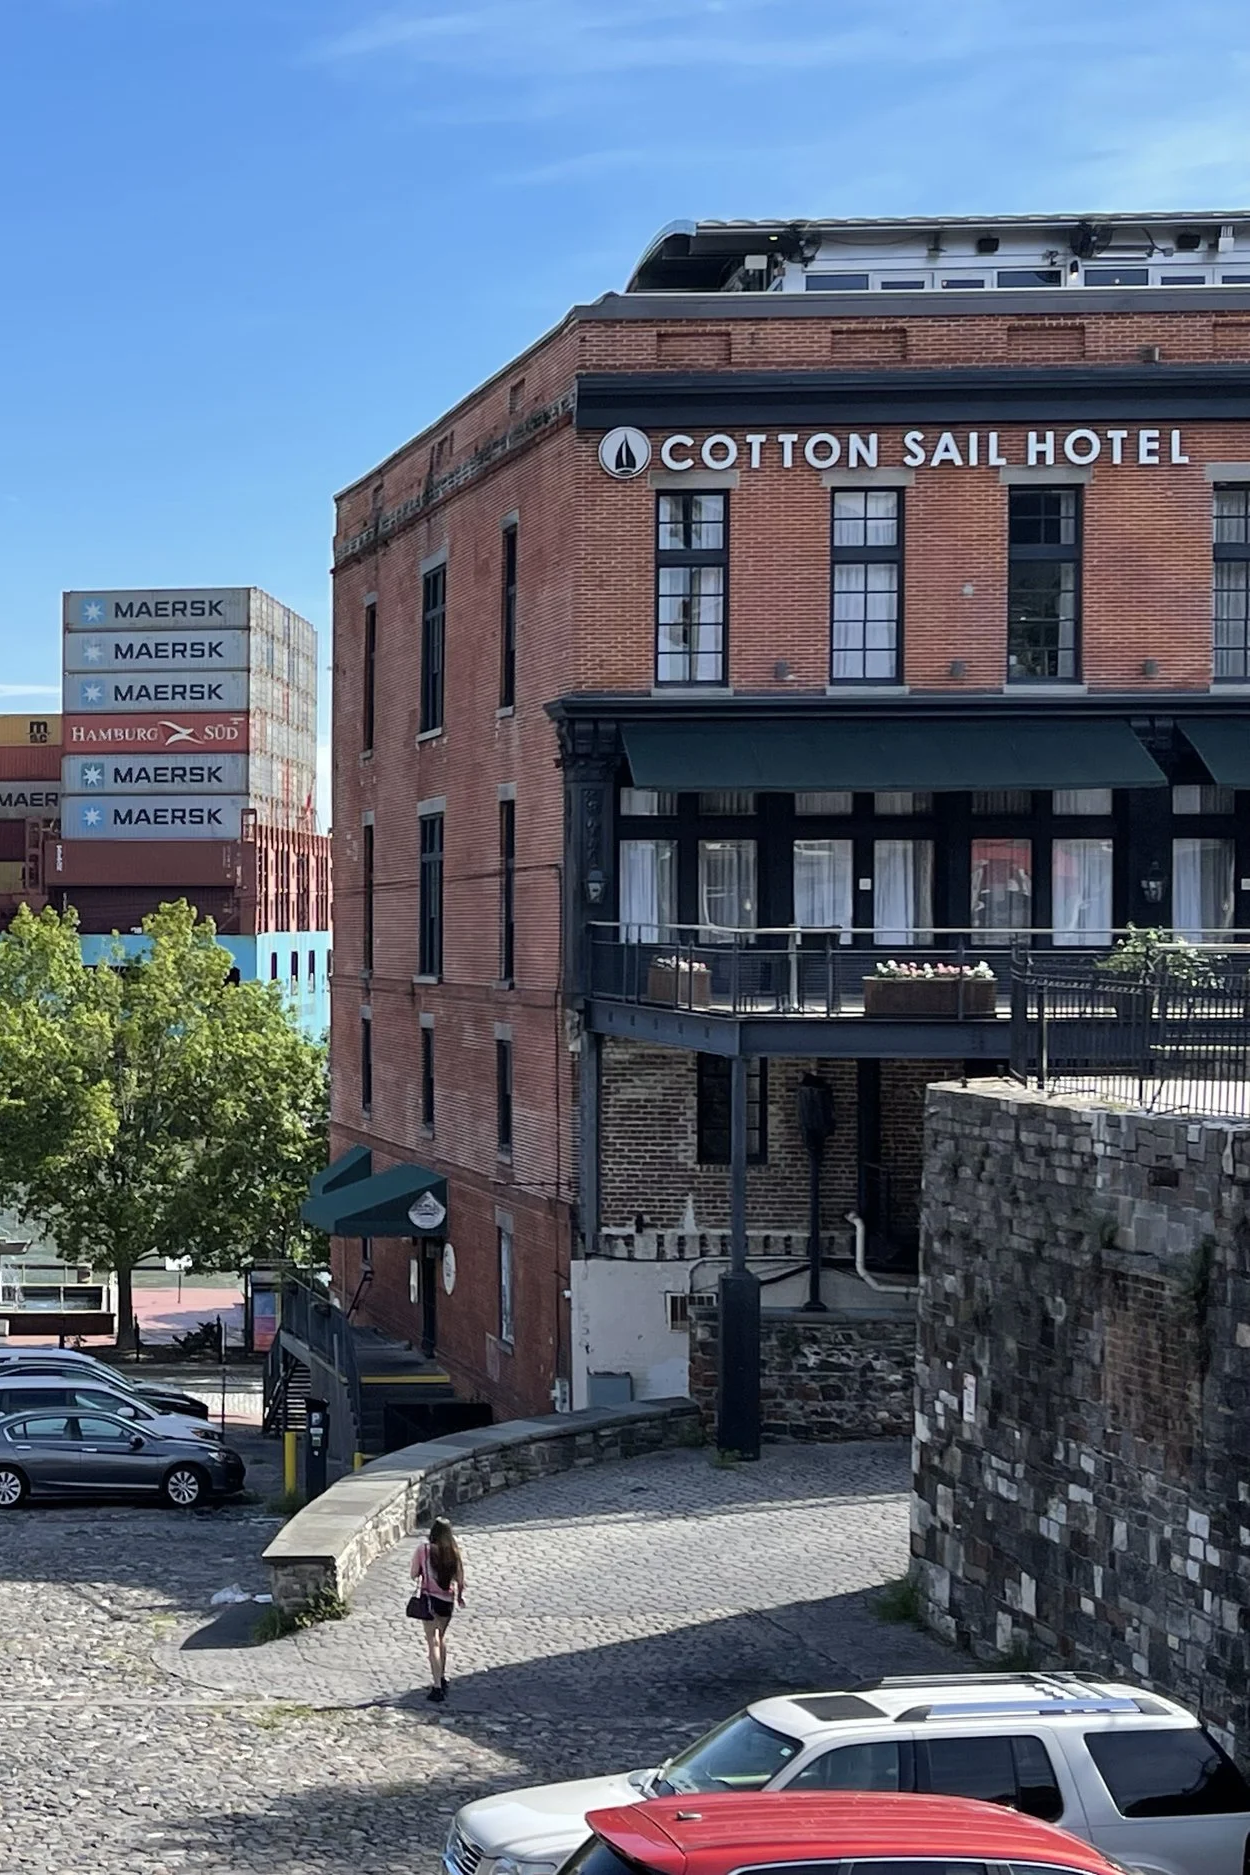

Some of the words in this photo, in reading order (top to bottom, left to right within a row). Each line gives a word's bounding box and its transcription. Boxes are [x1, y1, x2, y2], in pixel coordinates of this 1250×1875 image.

[660, 432, 878, 472] COTTON
[903, 430, 1007, 468] SAIL
[1027, 428, 1190, 467] HOTEL
[114, 600, 223, 619] MAERSK
[114, 641, 223, 660] MAERSK
[113, 683, 223, 702] MAERSK
[72, 727, 159, 742] HAMBURG
[203, 724, 239, 741] SÜD
[113, 766, 223, 785] MAERSK
[113, 808, 223, 826] MAERSK
